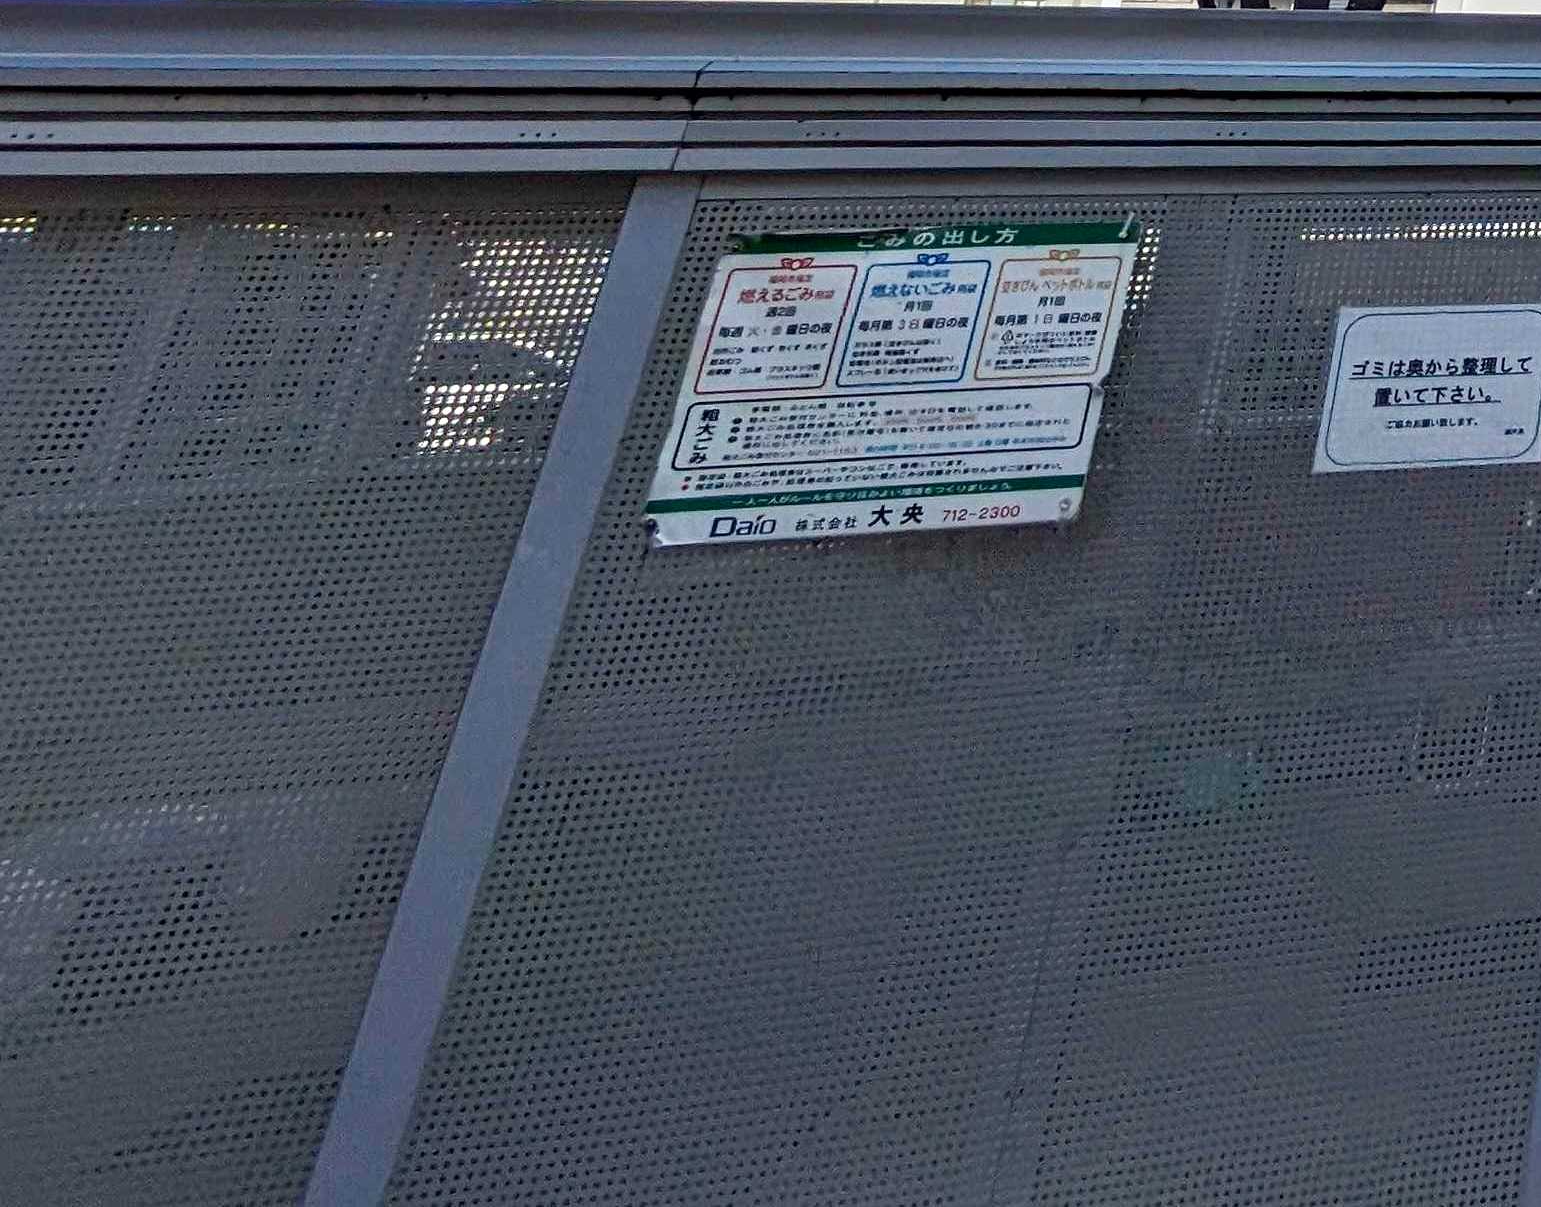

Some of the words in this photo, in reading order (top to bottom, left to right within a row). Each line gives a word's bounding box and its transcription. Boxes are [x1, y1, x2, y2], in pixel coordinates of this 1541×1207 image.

[857, 228, 1019, 248] ごみの出し方
[1351, 356, 1533, 377] ゴミは奥から整理して
[1374, 386, 1496, 407] 置いて下さい。
[709, 513, 777, 538] Daio
[795, 516, 857, 532] 株式会社
[868, 502, 926, 527] 大央
[941, 505, 1022, 523] 712-2300
